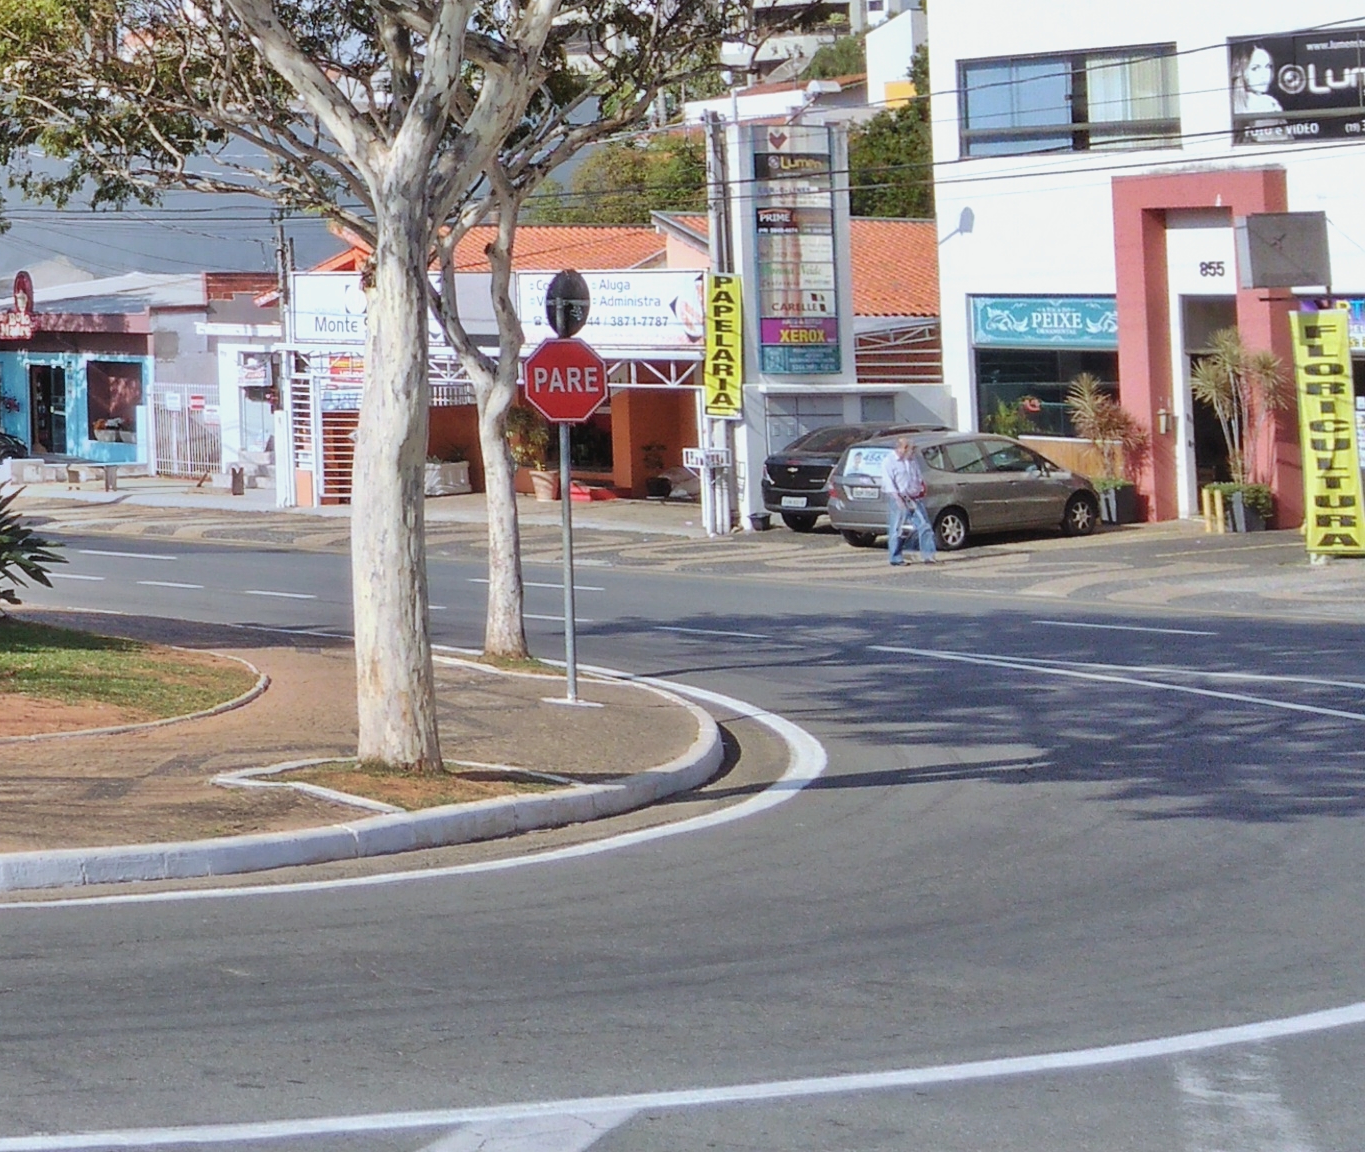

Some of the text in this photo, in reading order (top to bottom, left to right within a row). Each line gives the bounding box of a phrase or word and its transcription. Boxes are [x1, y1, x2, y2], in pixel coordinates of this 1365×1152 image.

[780, 156, 822, 169] Lumen
[759, 213, 791, 223] PRIME
[1199, 261, 1225, 277] 855
[599, 280, 631, 293] Aluga
[599, 297, 661, 307] Administra
[771, 302, 817, 312] CARELLE
[315, 315, 358, 333] Monte
[610, 316, 669, 327] 3871-7787
[1031, 312, 1083, 328] PEIXE
[710, 275, 735, 406] PAPELARIA
[780, 328, 825, 342] XEROX
[534, 367, 600, 393] PARE
[1304, 325, 1360, 547] FLORICULTURA
